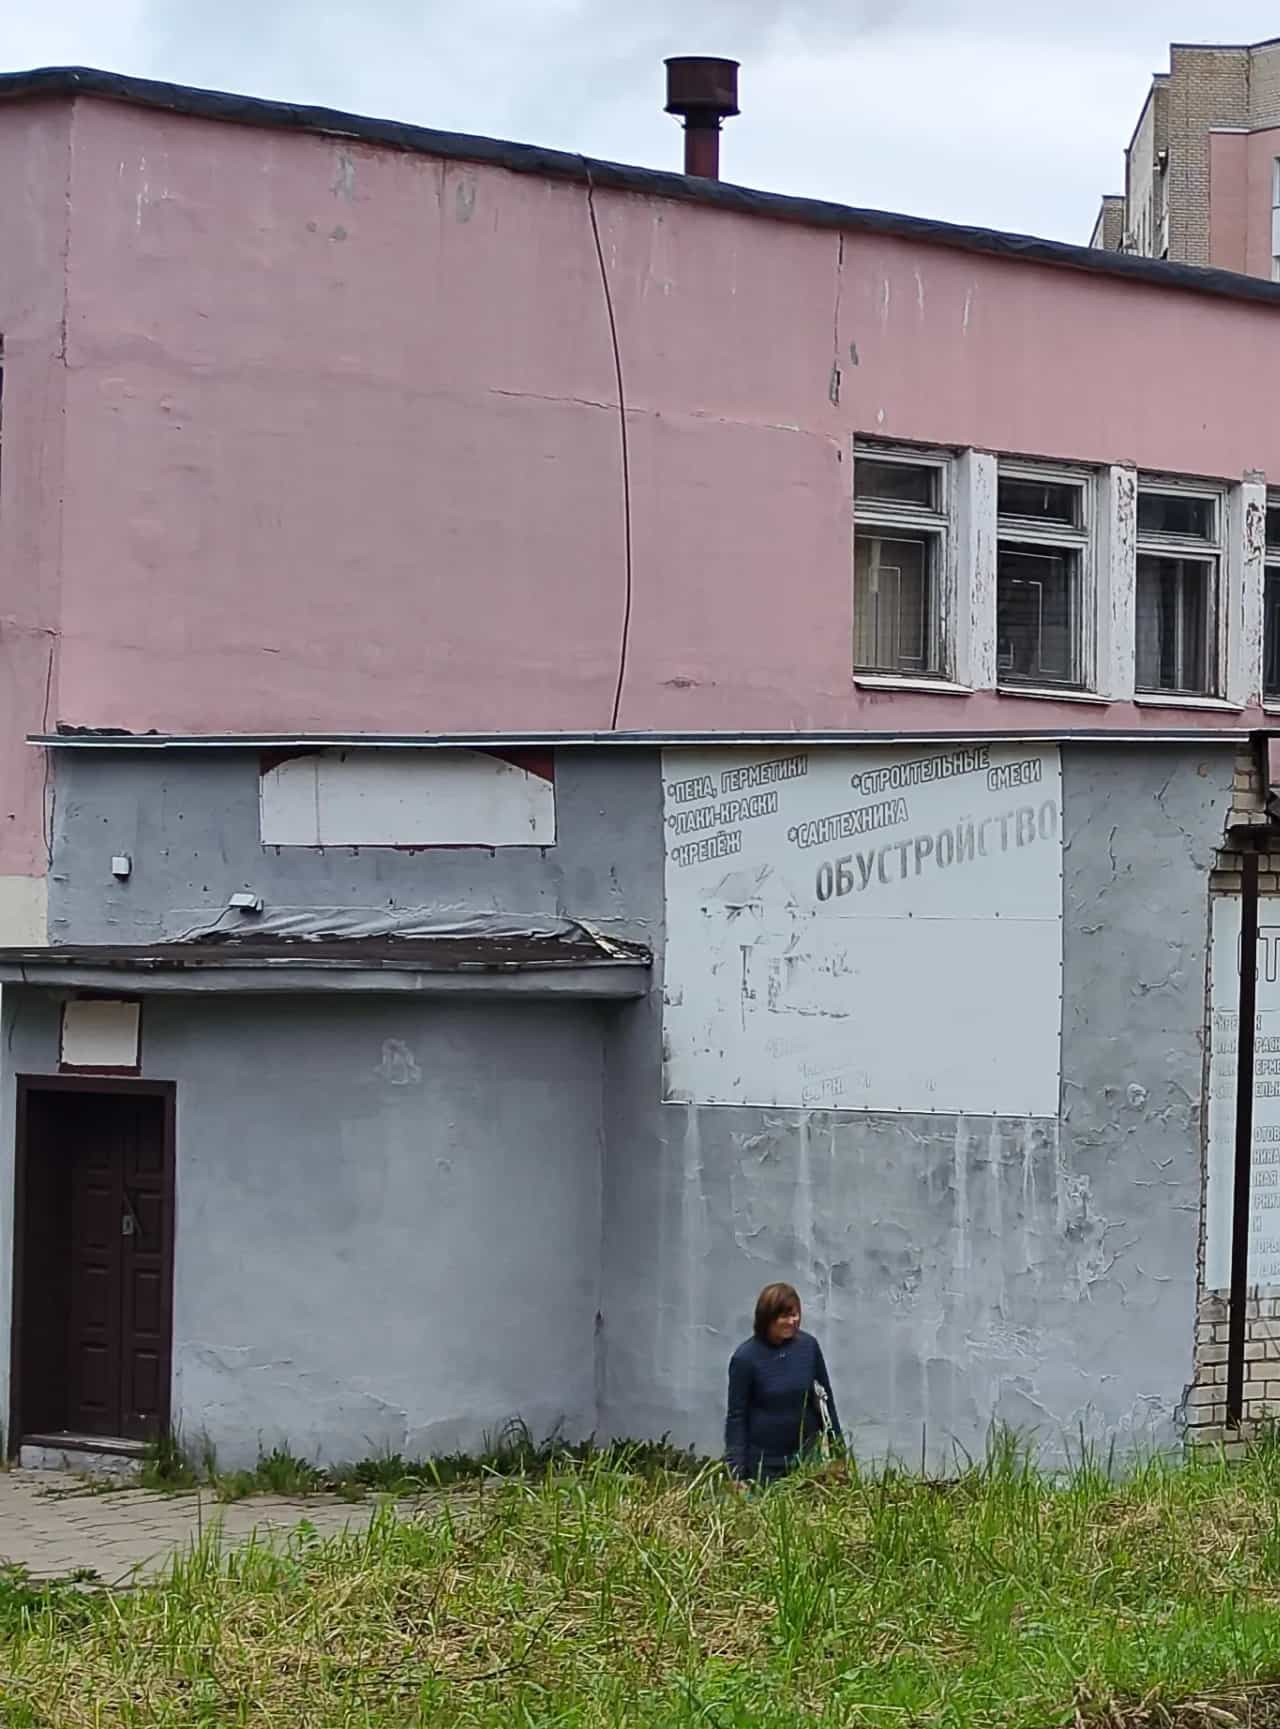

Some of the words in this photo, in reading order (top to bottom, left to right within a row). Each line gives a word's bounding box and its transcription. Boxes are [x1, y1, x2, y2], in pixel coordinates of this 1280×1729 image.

[720, 753, 808, 794] ГЕРМЕТИКИ
[987, 758, 1042, 792] СМЕСИ
[815, 799, 1058, 902] ОБУСТРОЙСТВО
